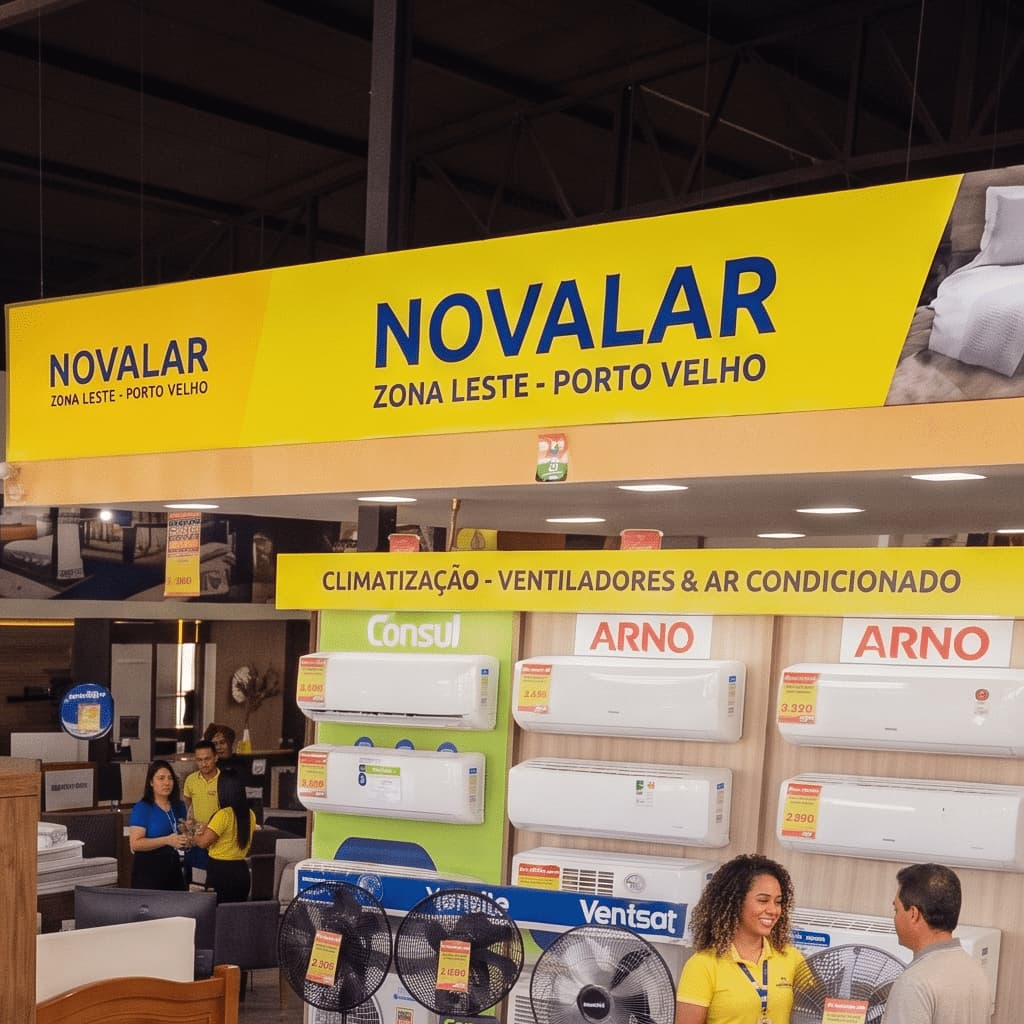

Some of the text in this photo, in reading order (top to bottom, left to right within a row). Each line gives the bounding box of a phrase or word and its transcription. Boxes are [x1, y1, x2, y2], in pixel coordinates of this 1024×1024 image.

[374, 256, 777, 368] NOVALAR
[49, 337, 209, 387] NOVALAR
[51, 394, 79, 407] ZONA
[82, 389, 116, 404] LESTE
[126, 385, 164, 400] PORTO
[168, 380, 208, 396] VELHO
[373, 381, 444, 408] ZONA
[451, 372, 529, 402] LESTE
[553, 362, 652, 396] PORTO
[661, 353, 766, 387] VELHO
[322, 564, 479, 596] CLIMATIZAÇÃO
[498, 568, 675, 592] VENTILADORES
[681, 569, 698, 592] &
[704, 570, 739, 592] AR
[746, 568, 961, 594] CONDICIONADO
[367, 614, 461, 649] Consul
[589, 621, 694, 654] ARNO
[854, 624, 990, 661] ARNO
[579, 899, 677, 934] Ventsat
